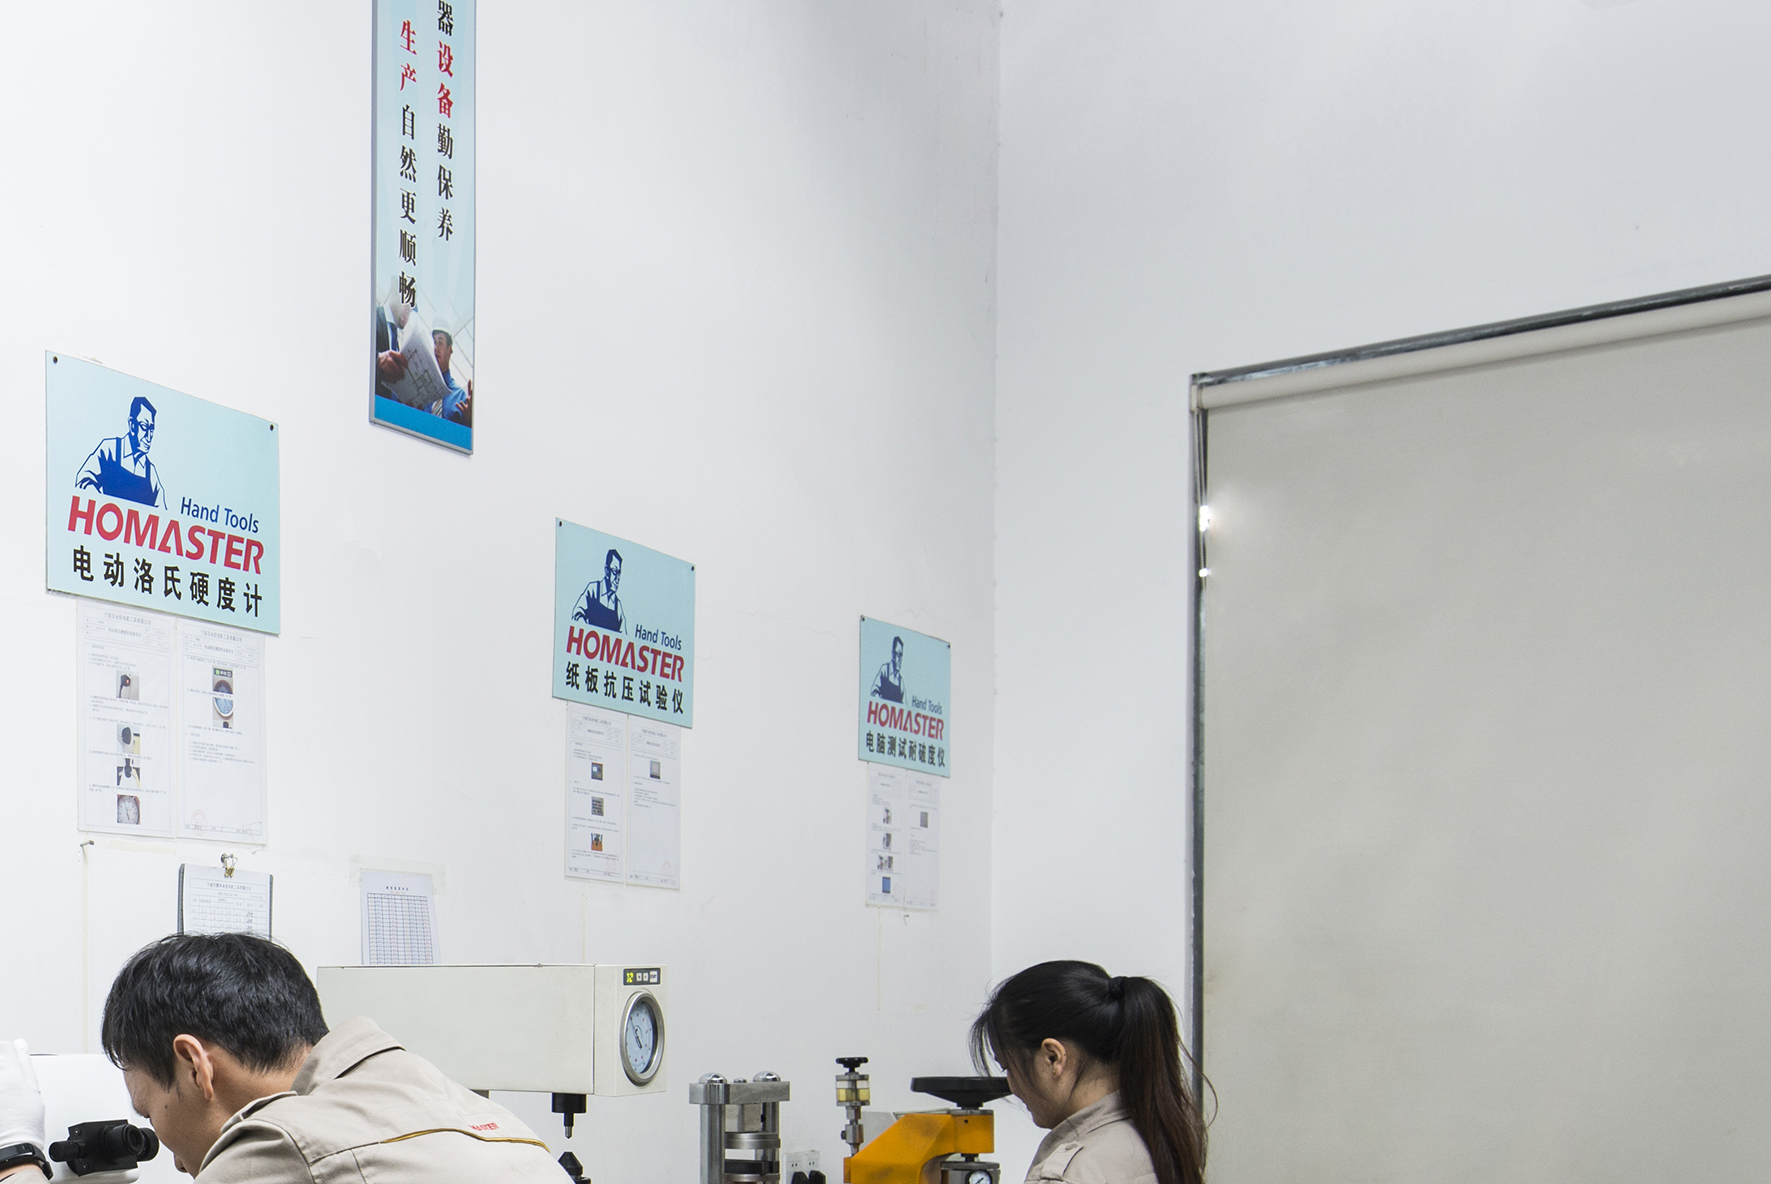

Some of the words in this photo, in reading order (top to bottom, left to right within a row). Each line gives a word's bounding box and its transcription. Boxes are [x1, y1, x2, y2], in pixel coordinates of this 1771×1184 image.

[437, 0, 454, 242] 器设备勤保养
[399, 20, 417, 308] 生产自然更顺畅
[68, 495, 264, 575] HOMASTER
[181, 496, 220, 523] Hand
[224, 508, 259, 533] Tools
[73, 545, 262, 617] 电动洛氏硬度计
[567, 625, 685, 682] HOMASTER
[635, 624, 659, 643] Hand
[661, 631, 682, 650] Tools
[566, 661, 684, 714] 纸板抗压试验仪
[912, 695, 927, 710] Hand
[928, 700, 942, 715] Tools
[867, 701, 944, 741] HOMASTER
